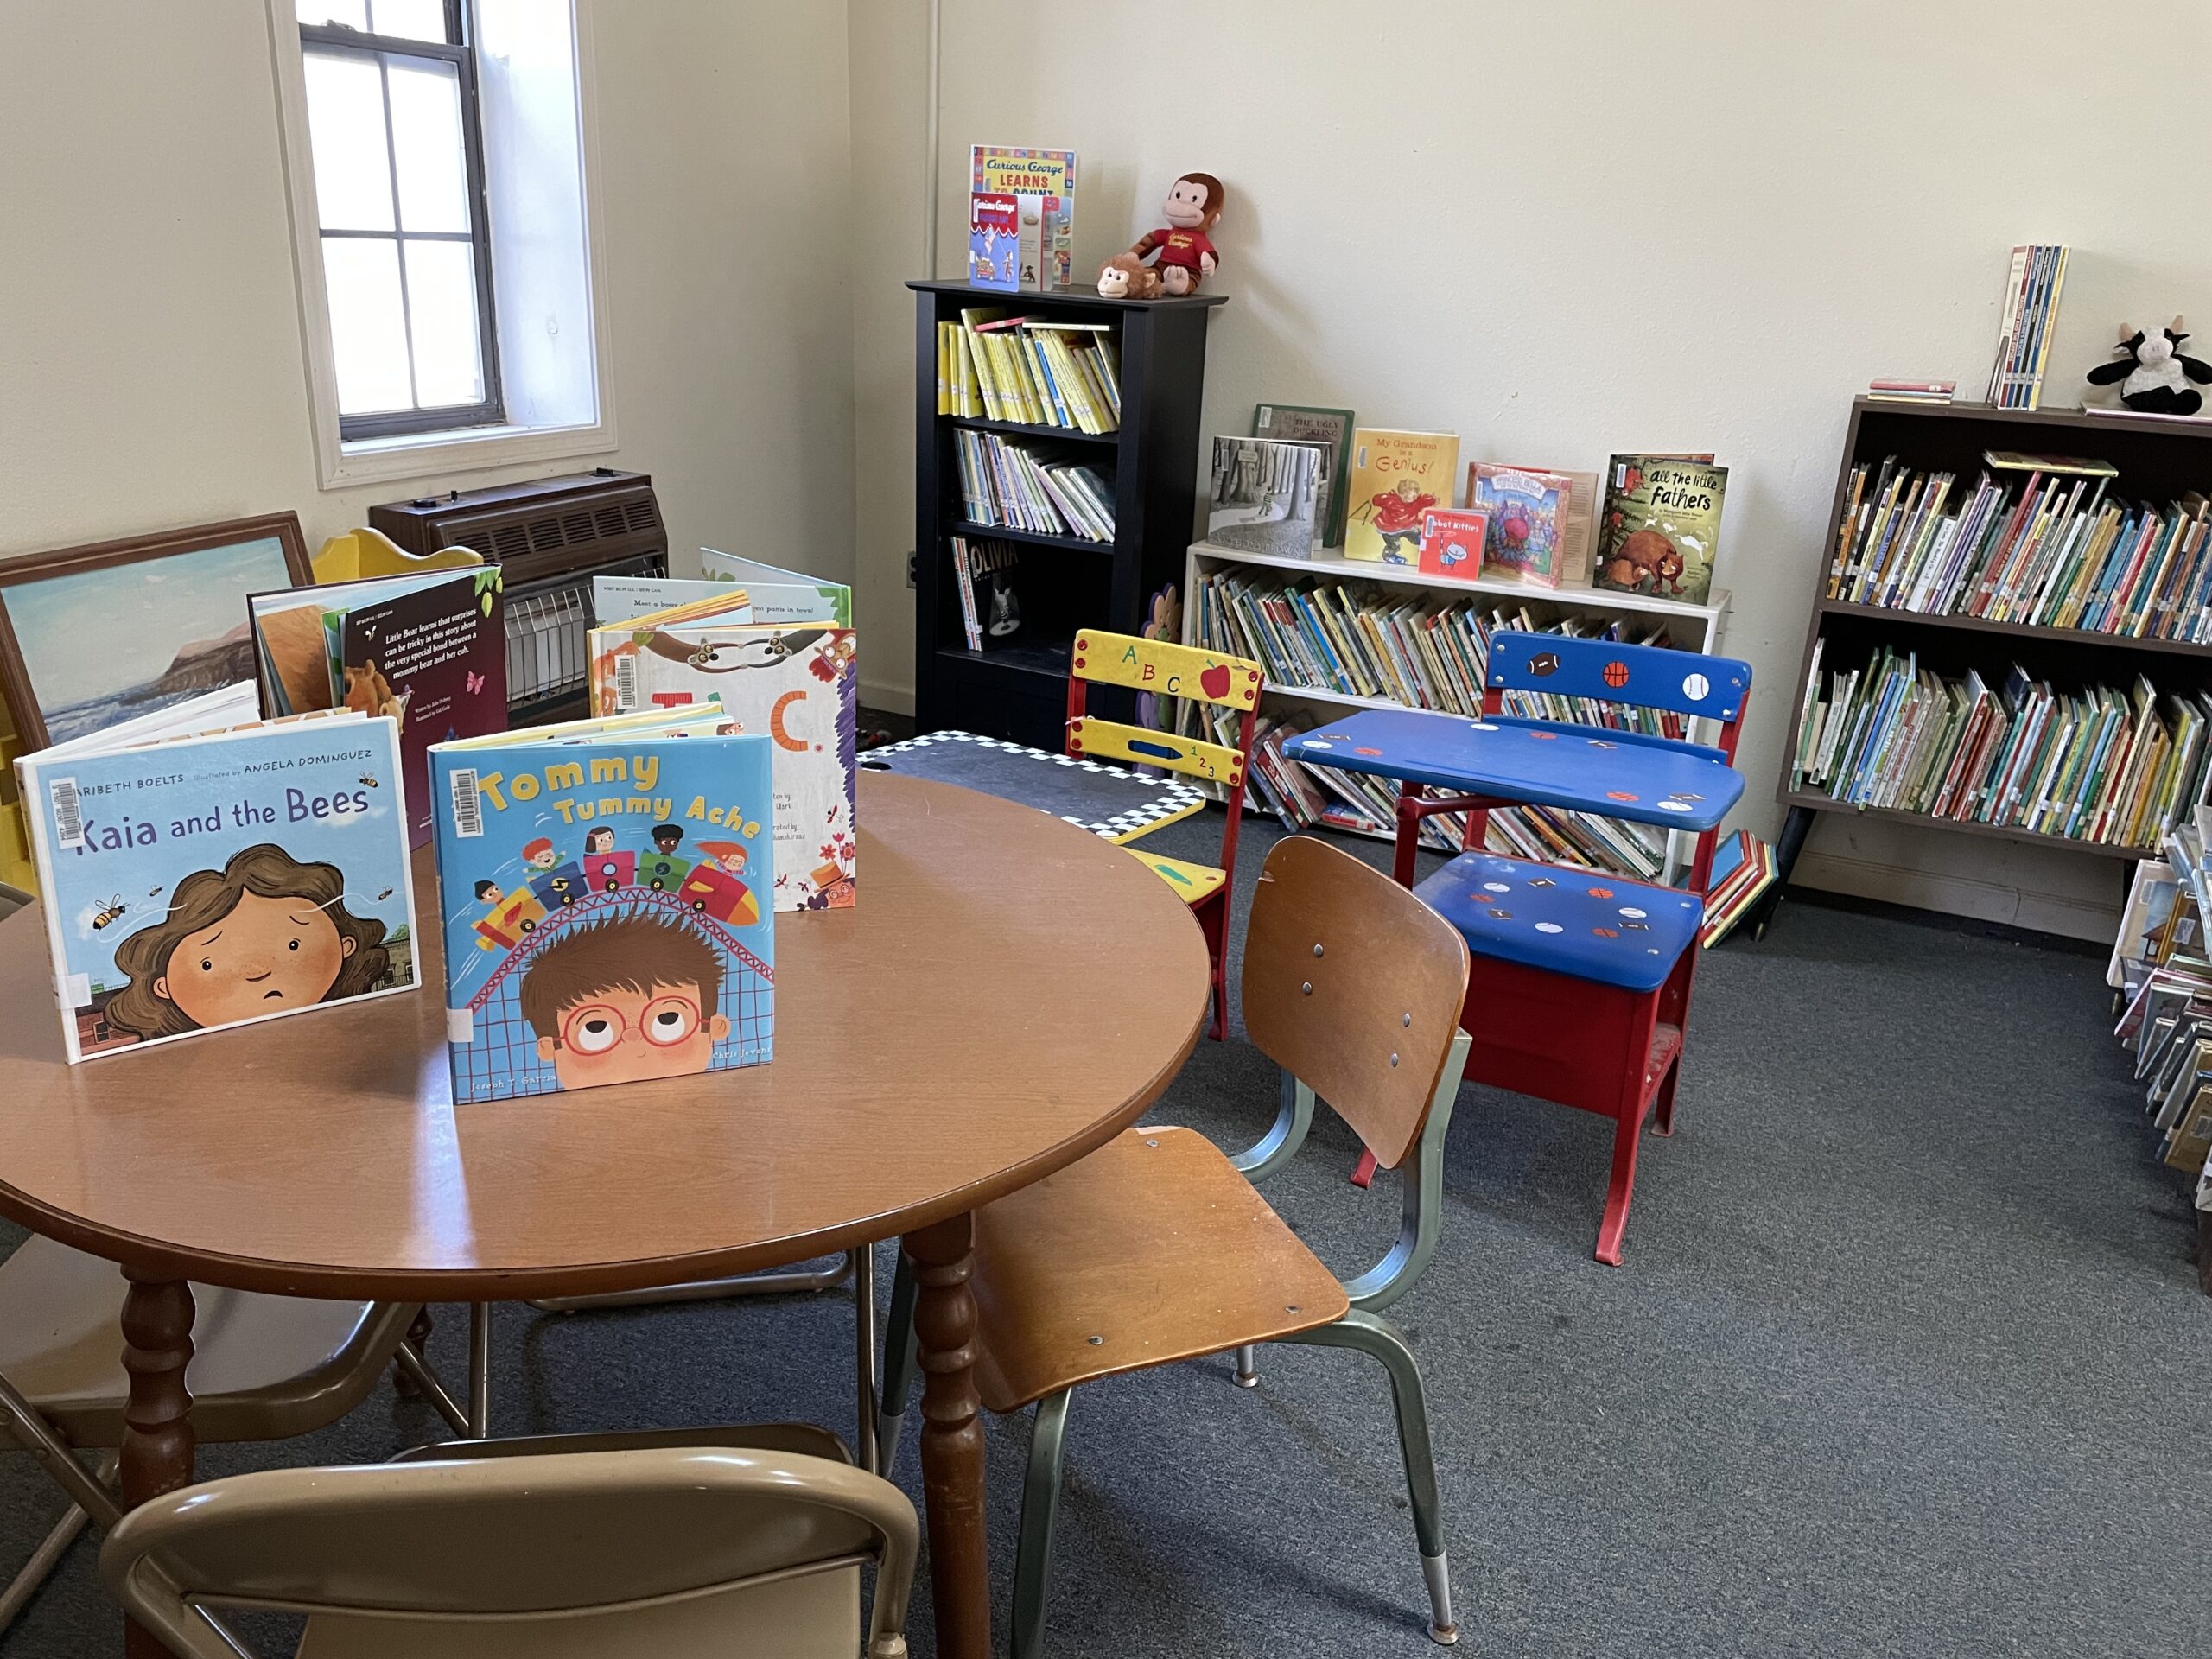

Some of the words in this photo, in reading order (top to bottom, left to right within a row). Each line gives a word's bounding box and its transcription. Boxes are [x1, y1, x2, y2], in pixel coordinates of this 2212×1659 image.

[987, 159, 1026, 170] Curious
[1027, 162, 1063, 176] George
[1000, 175, 1049, 188] LEARNS
[1293, 427, 1338, 437] DUCKLING
[1316, 420, 1338, 429] UGLY
[1377, 439, 1390, 448] My
[1393, 440, 1437, 450] Grandson
[1376, 456, 1434, 474] Genius!
[1650, 470, 1670, 483] all
[1673, 472, 1691, 486] the
[1694, 474, 1717, 490] little
[1433, 519, 1452, 528] obot
[1453, 522, 1479, 533] Kitties
[385, 632, 402, 645] Little
[403, 628, 418, 639] Bear
[419, 621, 437, 633] learns
[438, 616, 451, 626] that
[451, 608, 477, 622] surprises
[385, 647, 397, 658] can
[397, 644, 406, 652] be
[407, 637, 425, 650] tricky
[425, 635, 432, 644] in
[432, 631, 444, 641] this
[445, 626, 460, 637] story
[460, 620, 477, 632] about
[385, 660, 396, 671] the
[397, 655, 410, 666] very
[410, 645, 432, 662] special
[432, 639, 448, 652] bond
[448, 633, 472, 647] between
[1122, 645, 1137, 664] A
[392, 664, 418, 680] mommy
[419, 658, 433, 670] bear
[433, 652, 446, 664] and
[446, 651, 456, 660] her
[456, 645, 470, 656] cub.
[1142, 664, 1155, 681] B
[1167, 677, 1180, 693] C
[1191, 746, 1198, 756] 1
[1199, 757, 1206, 768] 2
[77, 781, 131, 797] RIBETH
[137, 773, 184, 789] BOELTS
[244, 760, 295, 774] ANGELA
[298, 750, 372, 766] DOMINGUEZ
[1208, 766, 1215, 777] 3
[479, 756, 658, 811] Tommy
[76, 816, 157, 855] Kaia
[171, 805, 222, 838] and
[232, 799, 276, 828] the
[286, 788, 369, 823] Bees
[553, 797, 671, 823] Tummy
[685, 795, 760, 839] Ache
[713, 1051, 738, 1059] Chris
[472, 1079, 505, 1092] Joseph
[508, 1078, 518, 1087] T.
